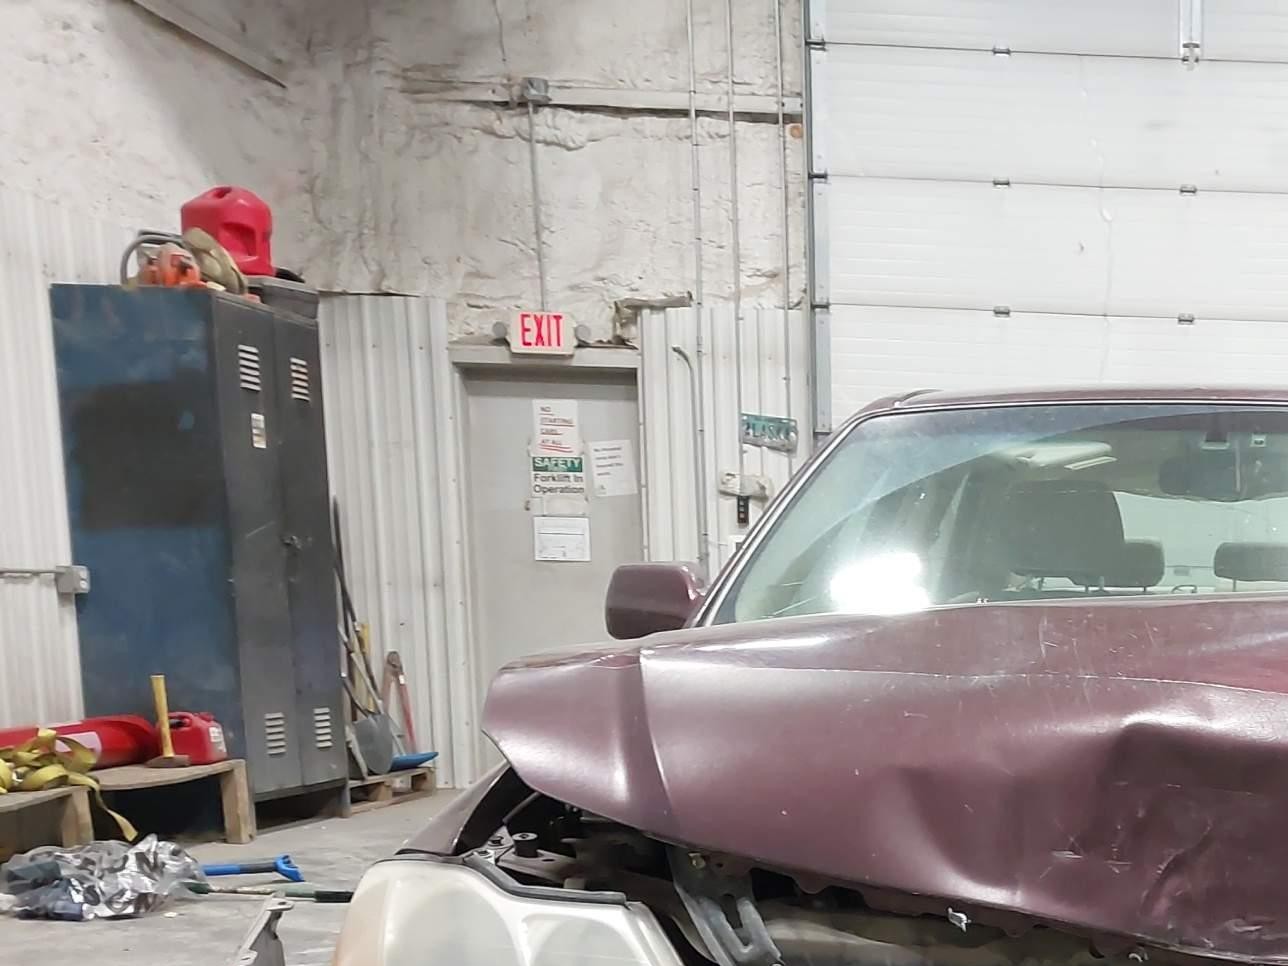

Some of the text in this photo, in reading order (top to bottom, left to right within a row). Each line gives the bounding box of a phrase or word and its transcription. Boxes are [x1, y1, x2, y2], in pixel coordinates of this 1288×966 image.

[520, 313, 562, 346] EXIT
[534, 458, 581, 469] SAFETY
[533, 473, 583, 483] Forklift In
[533, 484, 584, 495] Operation
